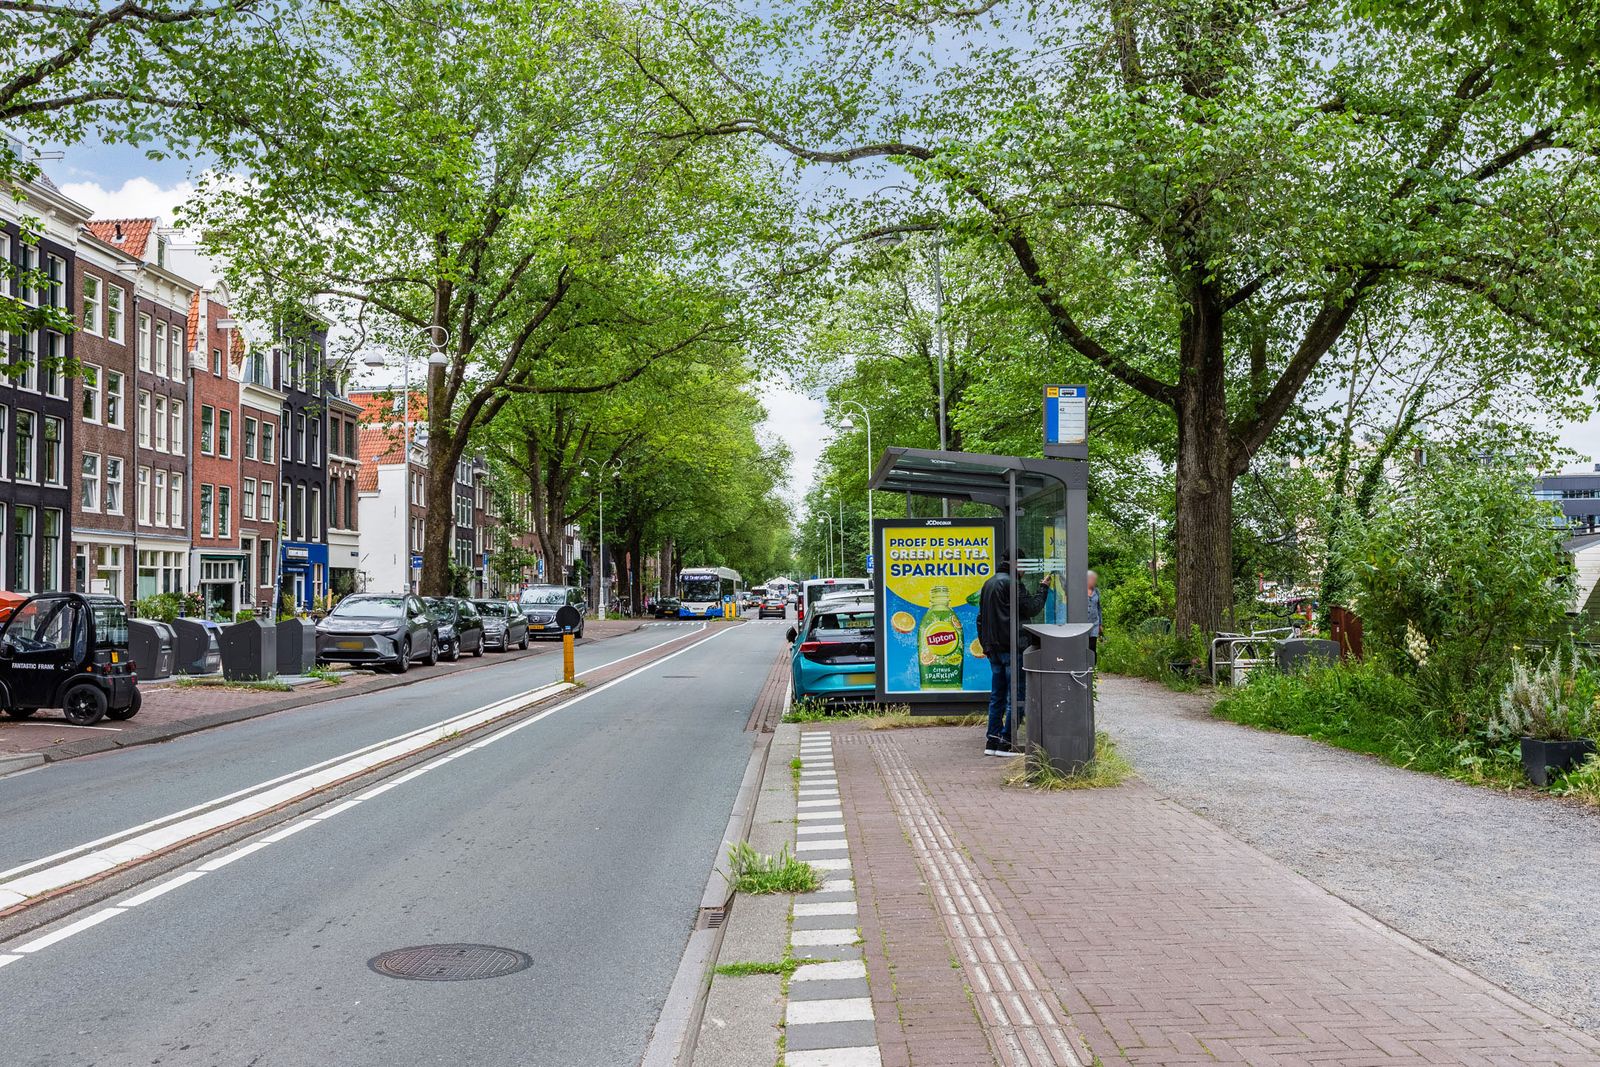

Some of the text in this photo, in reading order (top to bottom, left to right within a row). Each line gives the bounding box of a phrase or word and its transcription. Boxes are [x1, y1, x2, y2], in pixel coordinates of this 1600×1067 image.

[890, 538, 988, 547] PROEF DE SMAAK
[890, 548, 990, 560] GREEN ICE TEA
[890, 562, 990, 576] SPARKLING
[928, 634, 954, 644] Lipton
[925, 670, 958, 679] SPARKLING
